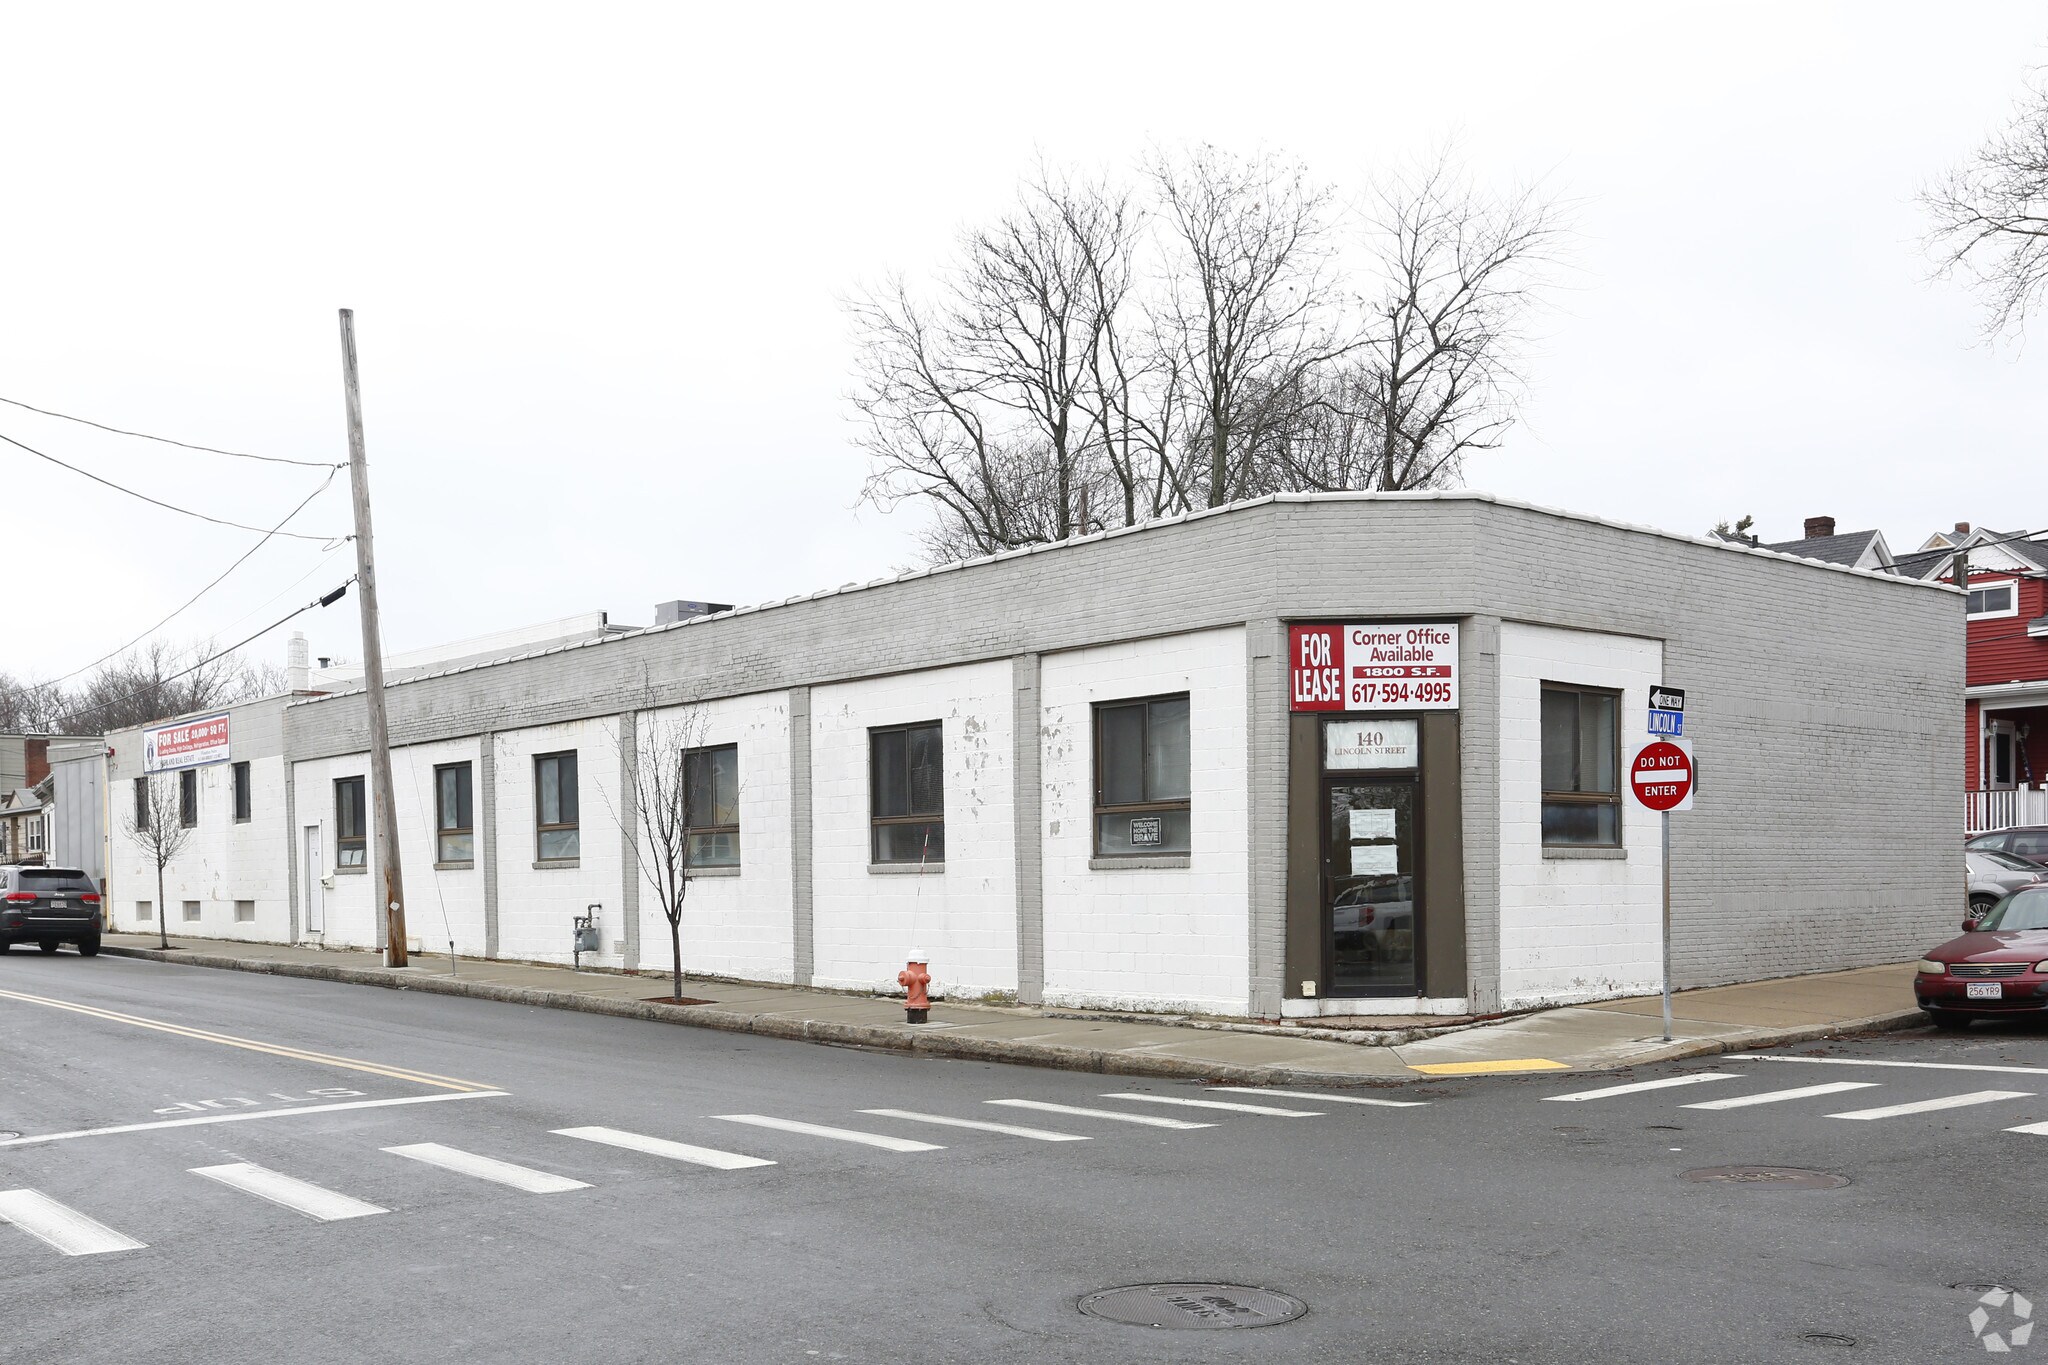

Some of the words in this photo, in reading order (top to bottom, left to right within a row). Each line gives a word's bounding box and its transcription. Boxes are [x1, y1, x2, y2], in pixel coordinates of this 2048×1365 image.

[1352, 630, 1401, 646] Corner
[1406, 628, 1450, 645] Office
[1301, 633, 1331, 667] FOR
[1370, 646, 1434, 662] Available
[1362, 667, 1405, 677] 1800
[1411, 667, 1441, 677] S.F.
[1294, 668, 1341, 702] LEASE
[1660, 695, 1669, 706] ONE
[1671, 697, 1681, 706] WAY
[1649, 712, 1676, 733] LINCOLN
[159, 733, 171, 747] FOR
[173, 729, 190, 744] SALE
[210, 724, 217, 735] SQ
[1357, 731, 1383, 746] 140
[1641, 757, 1655, 767] DO
[1660, 755, 1680, 766] NOT
[1645, 785, 1677, 796] ENTER
[1133, 833, 1158, 841] BRAVE
[1969, 987, 1984, 995] 256
[1985, 987, 2000, 995] YR9
